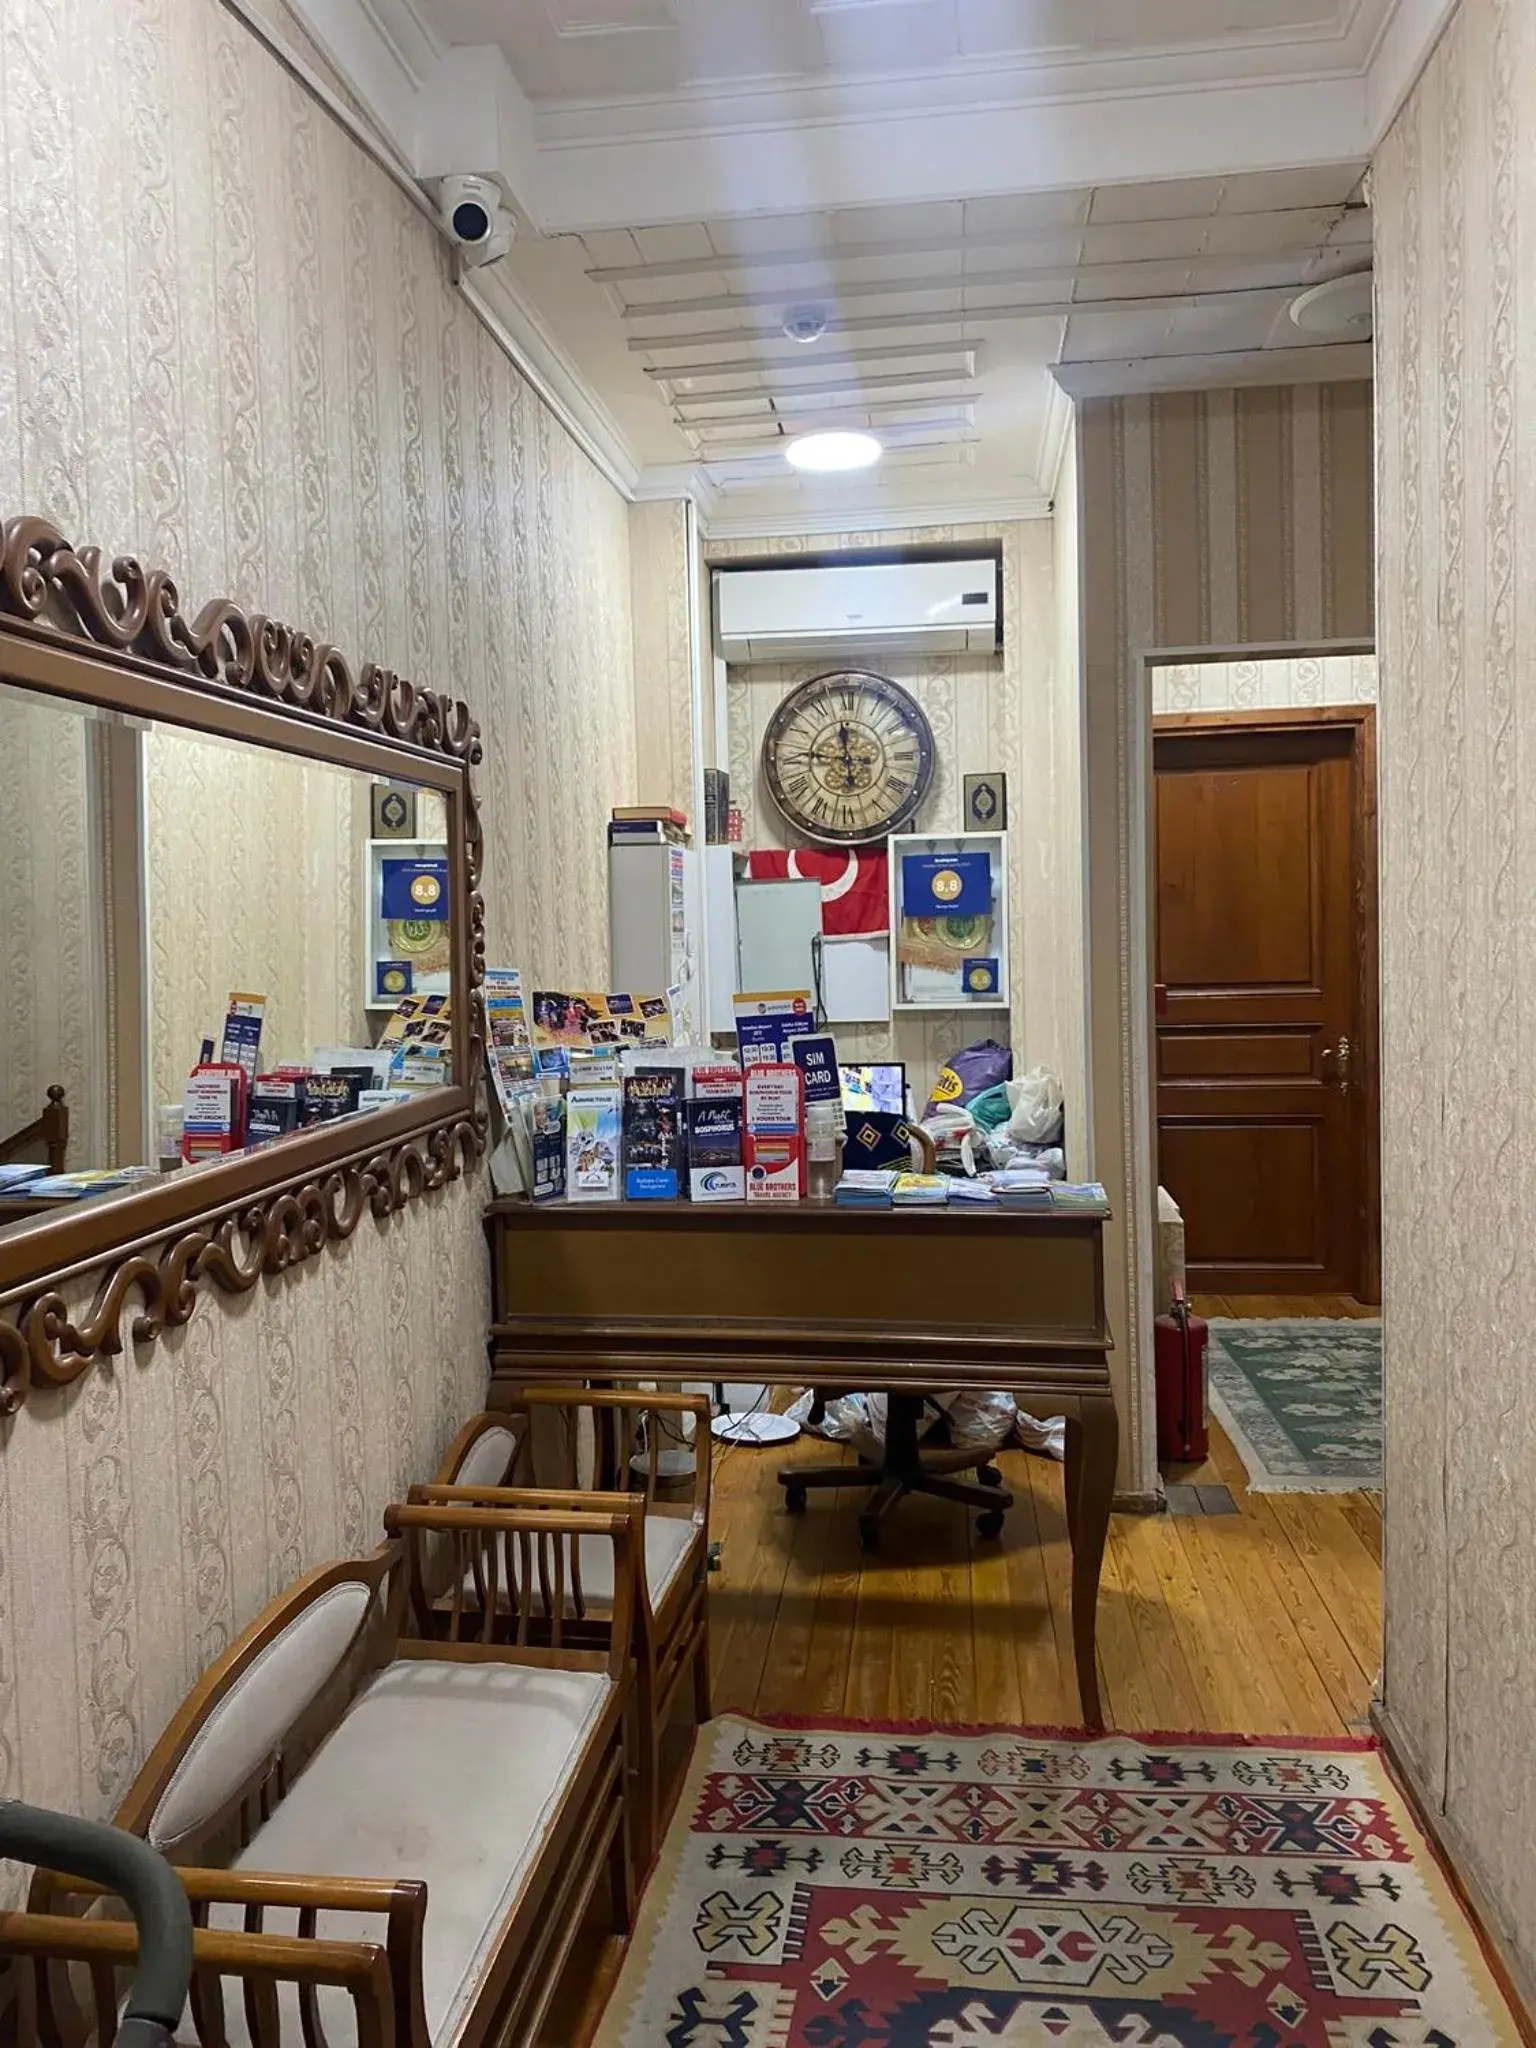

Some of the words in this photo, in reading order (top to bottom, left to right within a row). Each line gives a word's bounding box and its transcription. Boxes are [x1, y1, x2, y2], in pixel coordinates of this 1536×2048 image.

[806, 1051, 825, 1066] SIM
[804, 1070, 831, 1085] CARD
[750, 1182, 765, 1192] BLUE
[766, 1181, 796, 1191] BROTHERS
